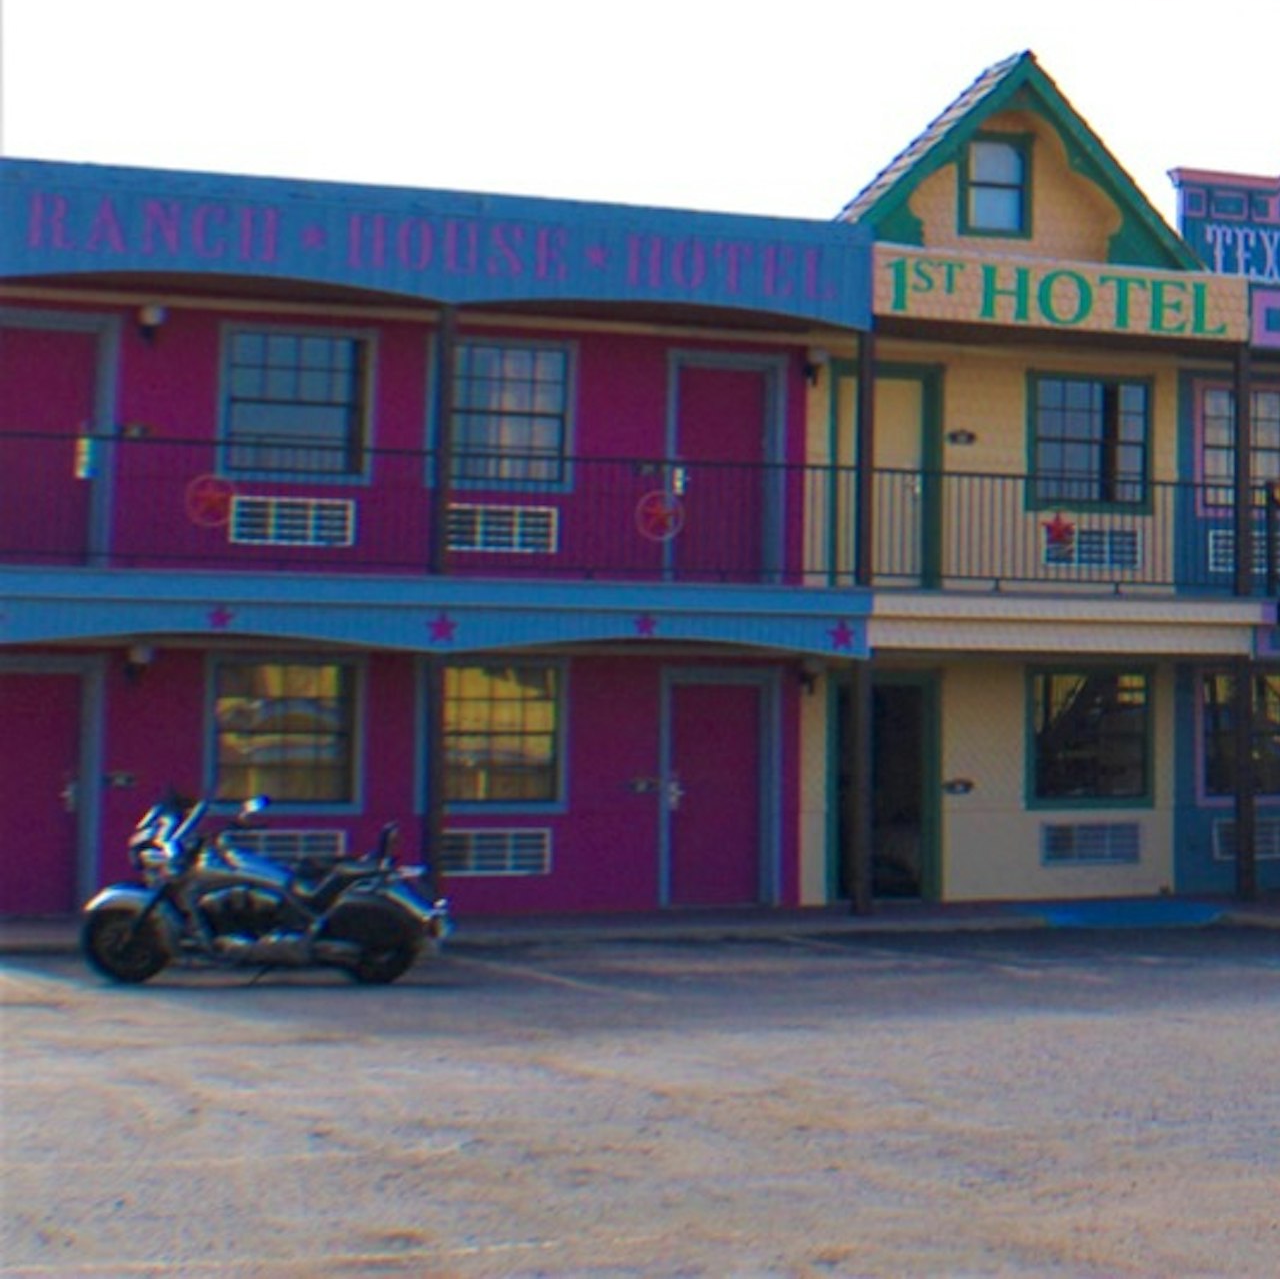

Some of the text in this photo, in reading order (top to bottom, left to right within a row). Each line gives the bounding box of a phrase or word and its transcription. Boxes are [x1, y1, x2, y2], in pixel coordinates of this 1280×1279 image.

[26, 191, 836, 300] RANCH HOUSE HOTEL
[885, 256, 1227, 336] 1ST HOTEL
